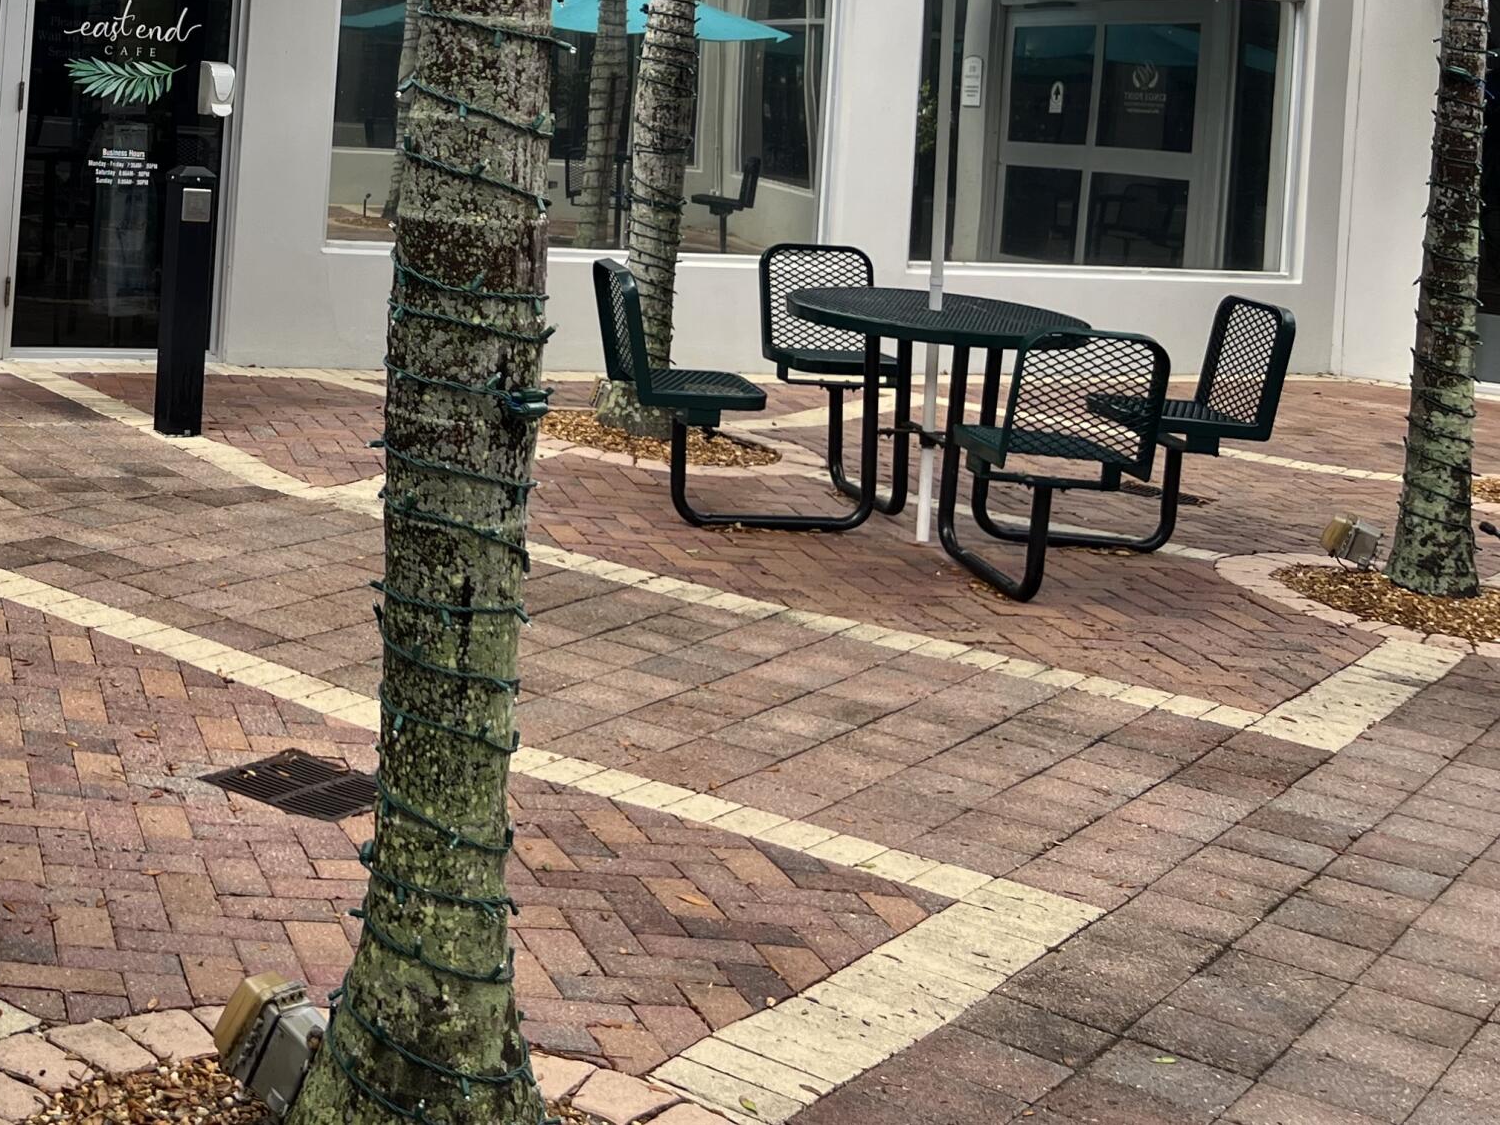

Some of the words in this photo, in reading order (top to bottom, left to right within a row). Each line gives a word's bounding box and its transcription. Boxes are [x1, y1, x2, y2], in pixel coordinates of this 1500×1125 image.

[63, 0, 136, 42] east
[135, 7, 202, 42] end
[104, 44, 157, 58] CAFE
[102, 147, 128, 157] Business
[128, 149, 145, 158] Hours
[88, 160, 106, 168] Monday
[95, 168, 116, 177] Saturday
[95, 177, 113, 185] Sunday
